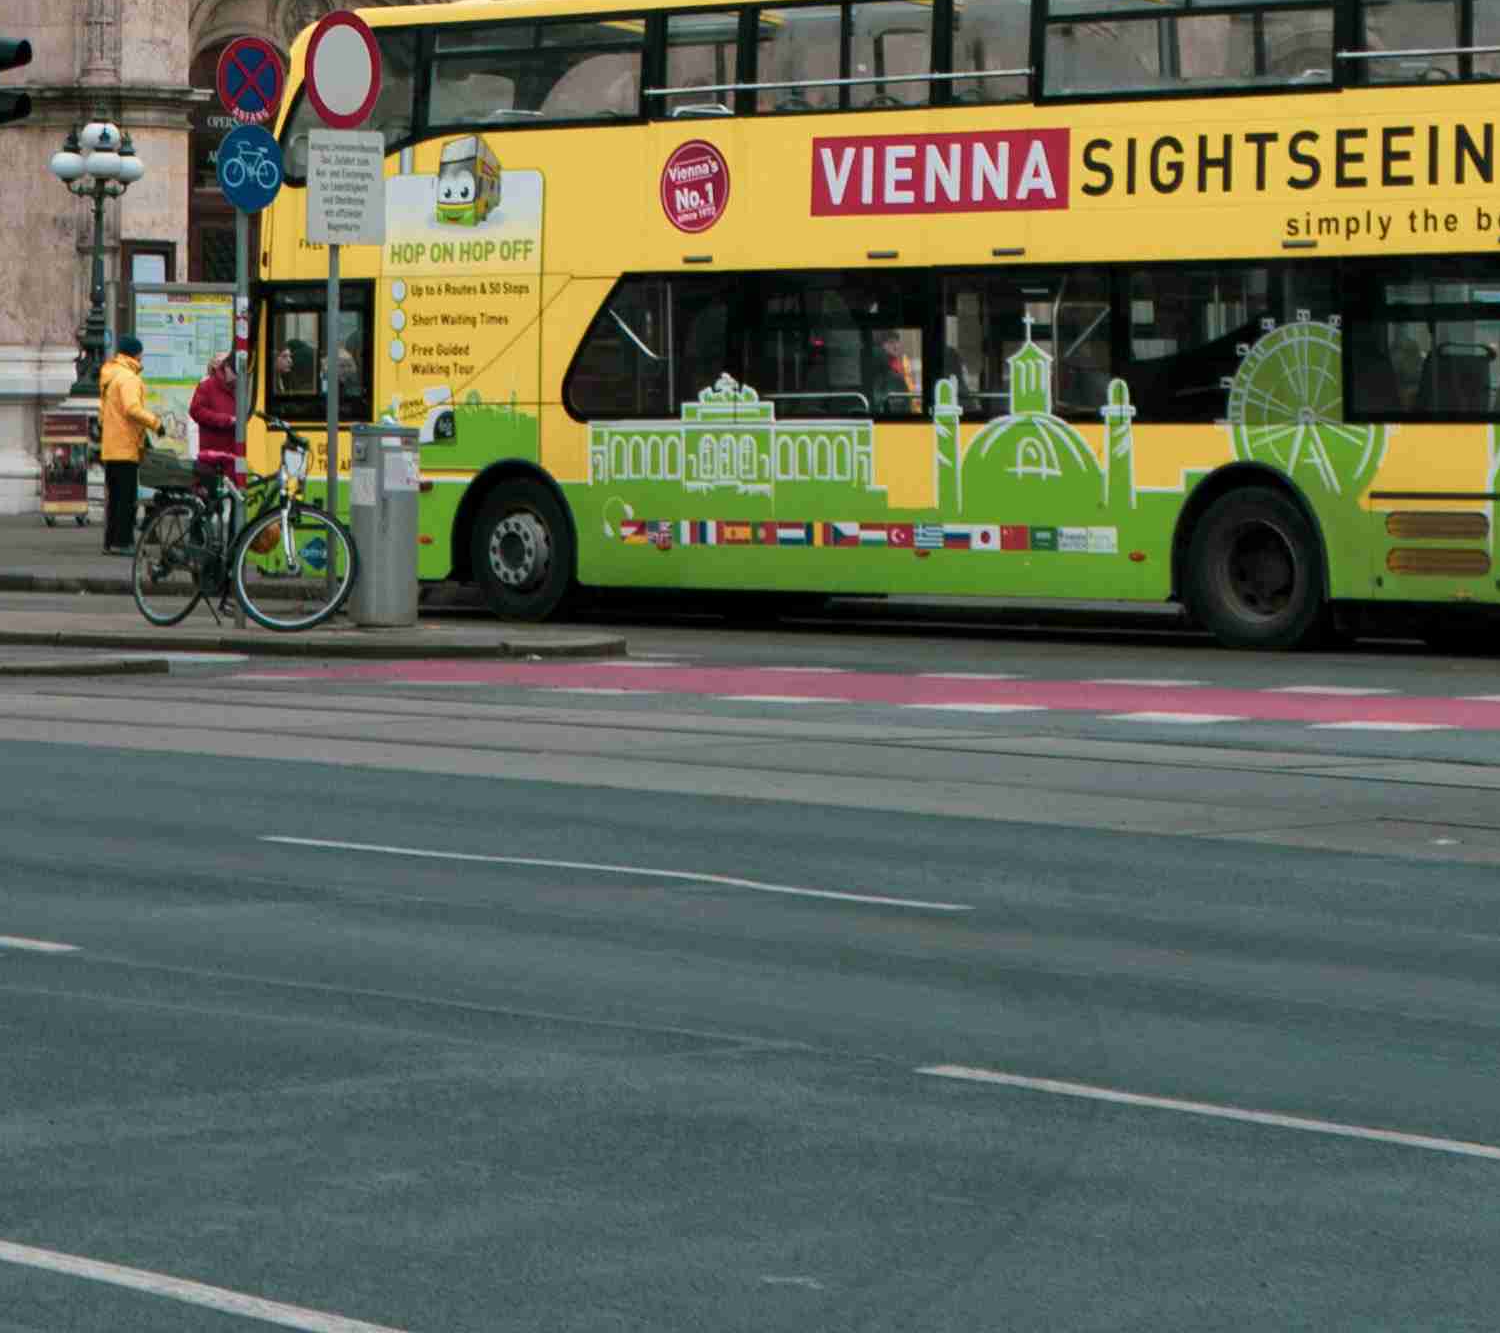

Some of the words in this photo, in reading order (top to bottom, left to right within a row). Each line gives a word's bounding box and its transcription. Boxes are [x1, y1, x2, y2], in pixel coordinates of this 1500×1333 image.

[667, 157, 719, 182] Vienna's
[820, 139, 1057, 206] VIENNA
[675, 182, 715, 214] No.1
[1286, 209, 1393, 242] simply
[1409, 208, 1459, 233] the
[390, 243, 426, 264] HOP
[430, 242, 455, 263] ON
[459, 241, 496, 262] HOP
[499, 240, 535, 262] OFF
[411, 284, 424, 297] Up
[425, 284, 436, 296] to
[444, 283, 478, 296] Routes
[480, 282, 487, 295] &
[489, 282, 502, 295] 50
[503, 282, 531, 298] Stops
[411, 314, 439, 327] Short
[440, 313, 478, 329] Waiting
[479, 312, 509, 326] Times
[411, 343, 435, 357] Free
[435, 342, 471, 357] Guided
[410, 362, 451, 378] Walking
[453, 362, 475, 375] Tour
